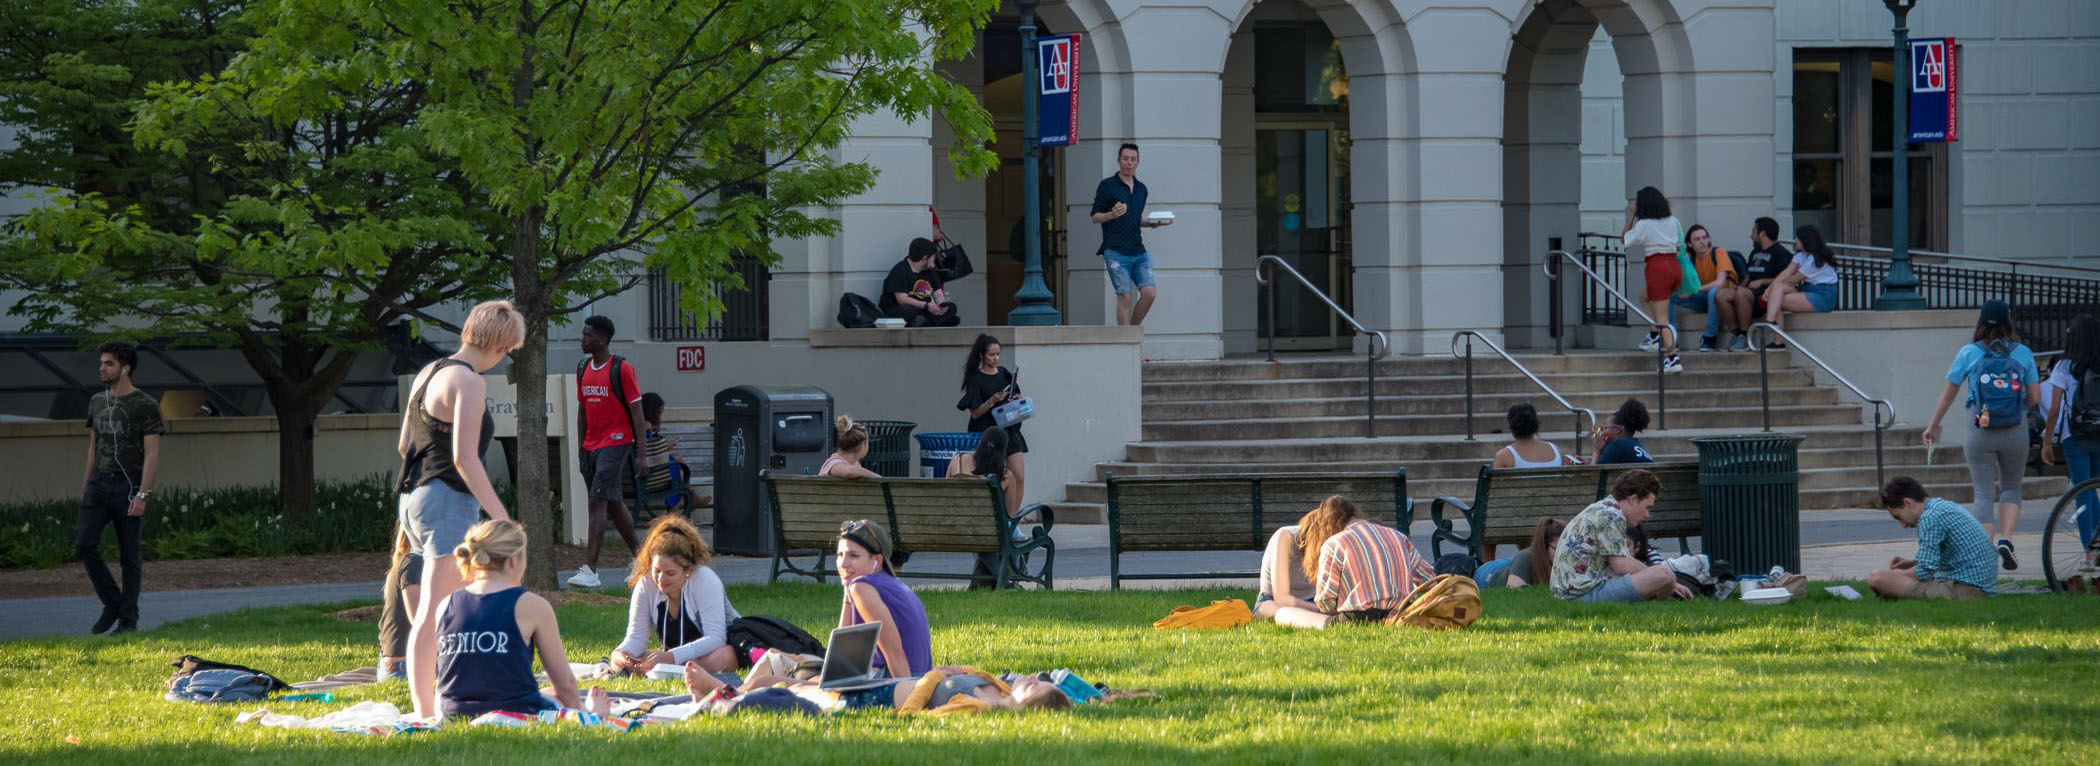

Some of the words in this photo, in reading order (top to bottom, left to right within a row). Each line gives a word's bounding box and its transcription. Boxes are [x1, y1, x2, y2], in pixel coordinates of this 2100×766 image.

[1072, 41, 1080, 92] UNIVERSITY
[1948, 44, 1956, 92] UNIVERSITY
[679, 348, 703, 369] FDC
[438, 631, 508, 657] SENIOR
